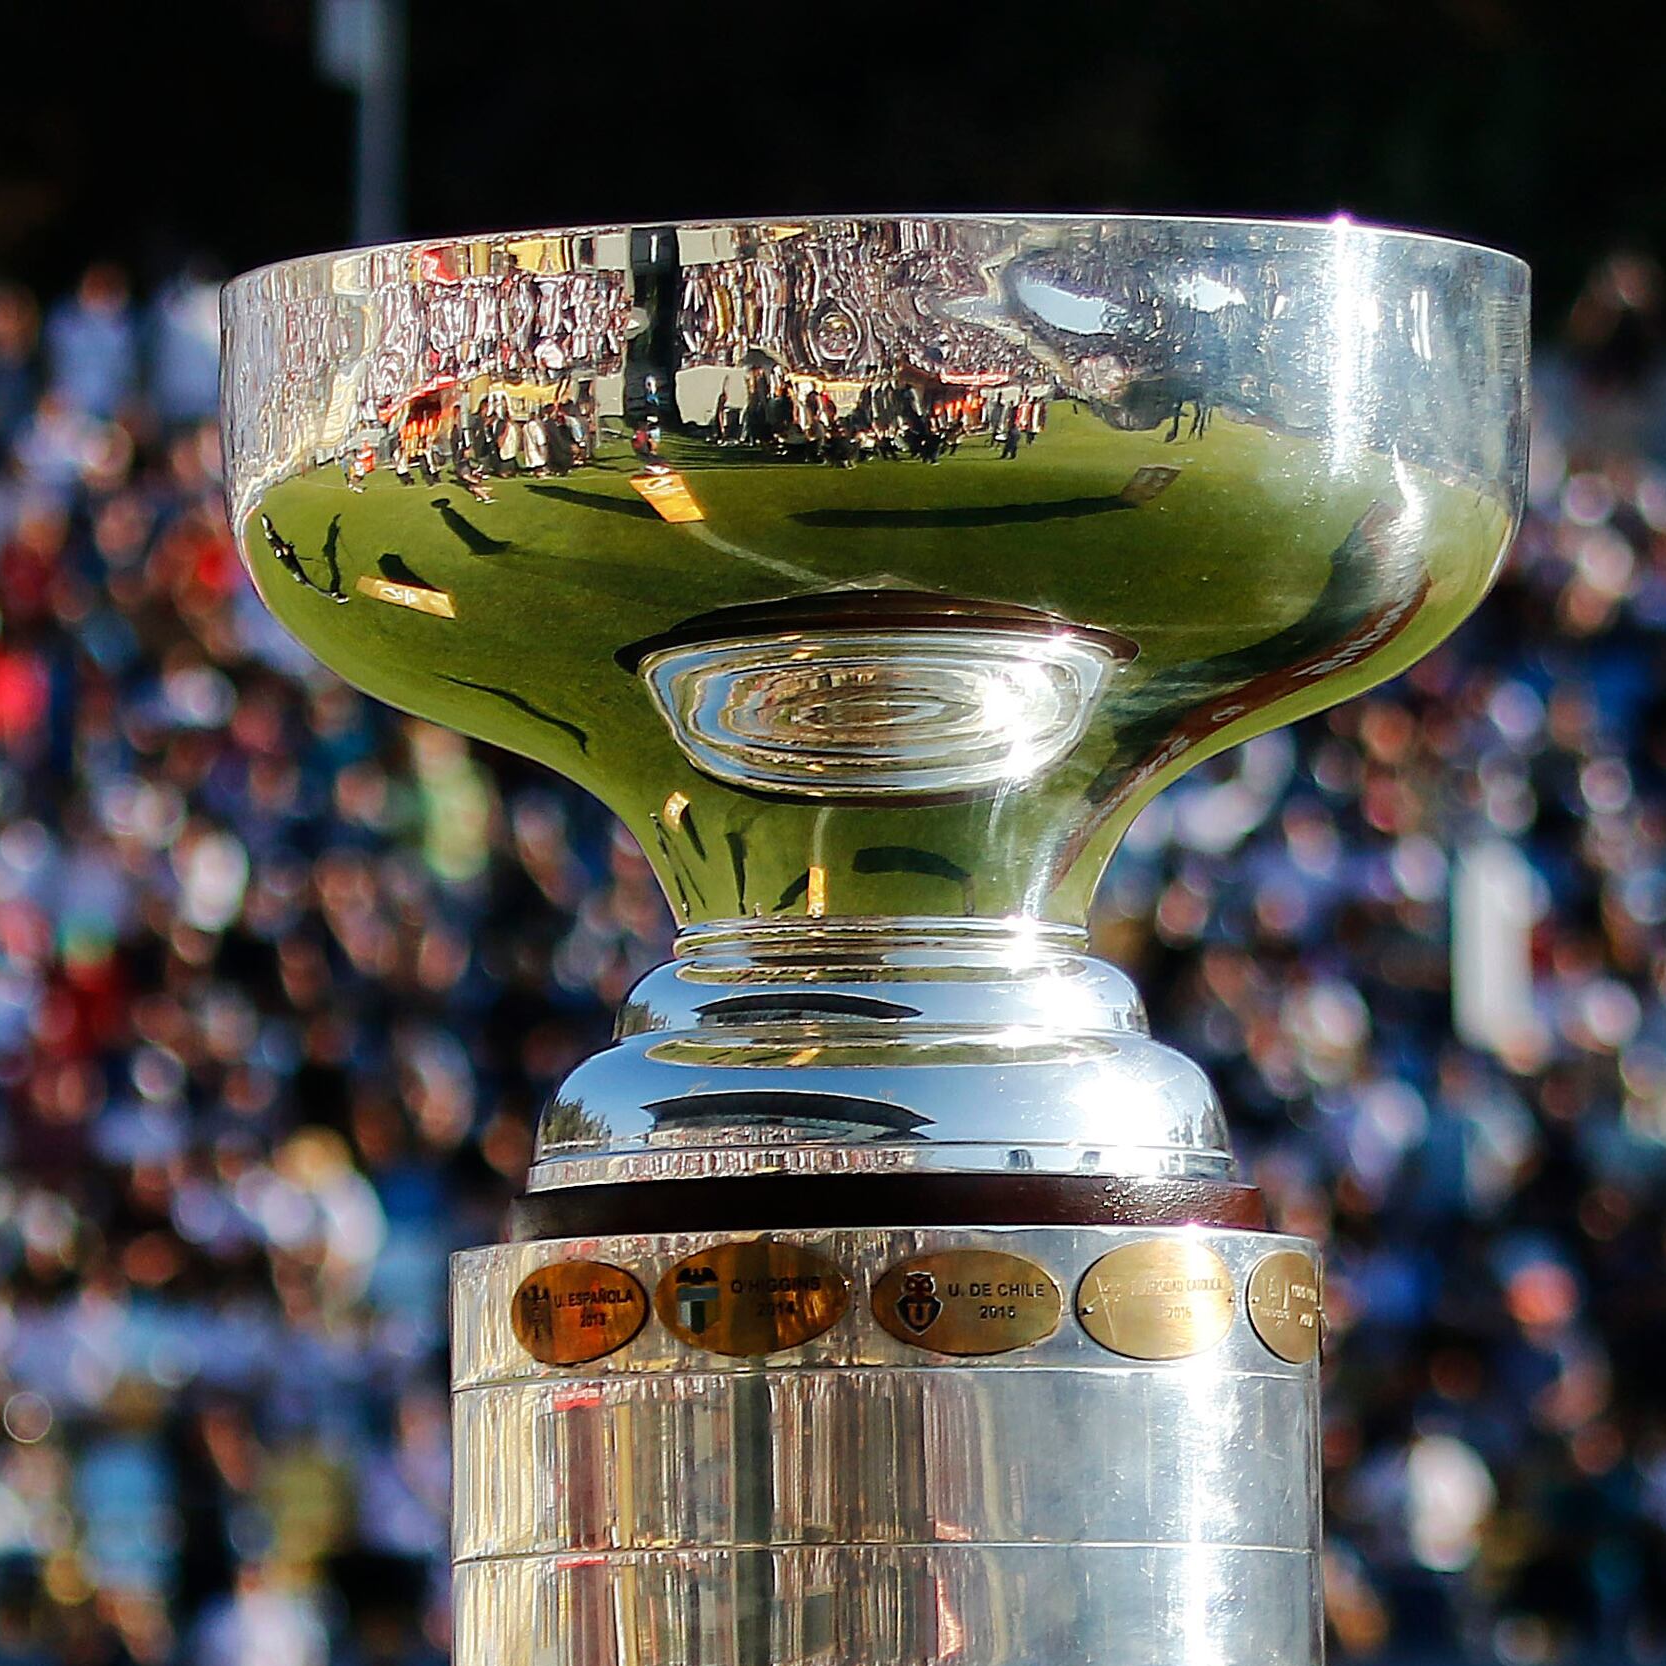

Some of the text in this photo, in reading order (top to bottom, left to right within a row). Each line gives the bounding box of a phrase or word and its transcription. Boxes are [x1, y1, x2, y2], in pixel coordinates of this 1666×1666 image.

[568, 1286, 633, 1308] ESPAÑOLA
[947, 1283, 1045, 1298] U. DE CHILE
